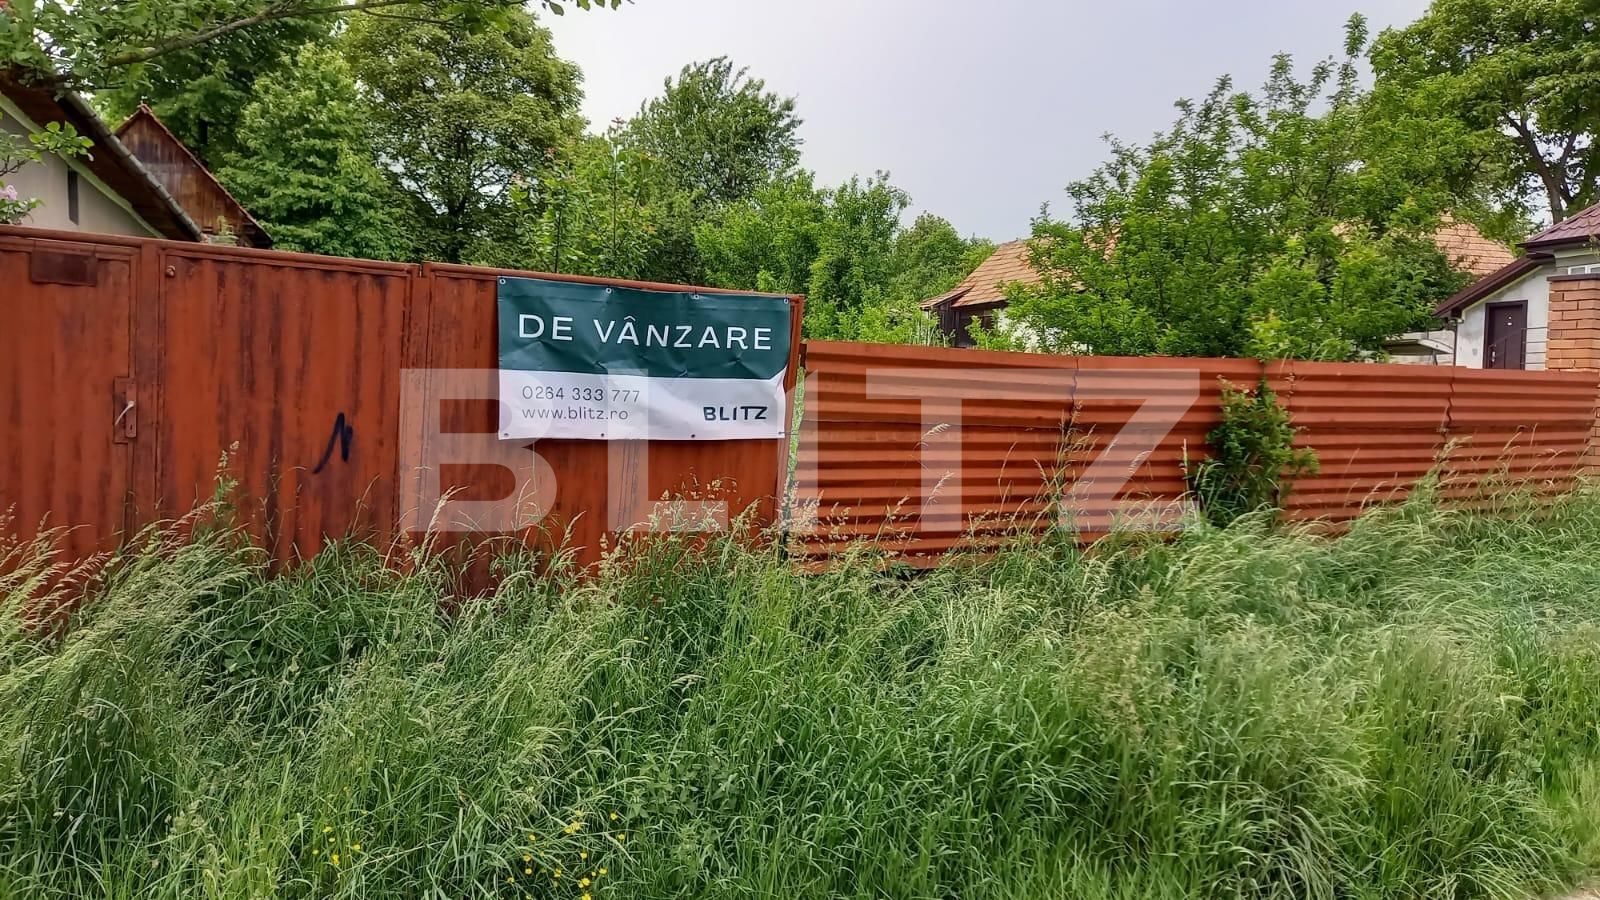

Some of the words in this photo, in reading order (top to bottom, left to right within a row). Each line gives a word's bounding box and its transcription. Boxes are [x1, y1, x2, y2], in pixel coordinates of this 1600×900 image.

[518, 313, 574, 341] DE
[593, 315, 772, 351] VÂNZARE
[522, 385, 564, 401] 0264
[571, 387, 604, 402] 333
[611, 389, 640, 403] 777
[522, 406, 628, 421] www.blitz.ro
[703, 405, 768, 421] BLITZ
